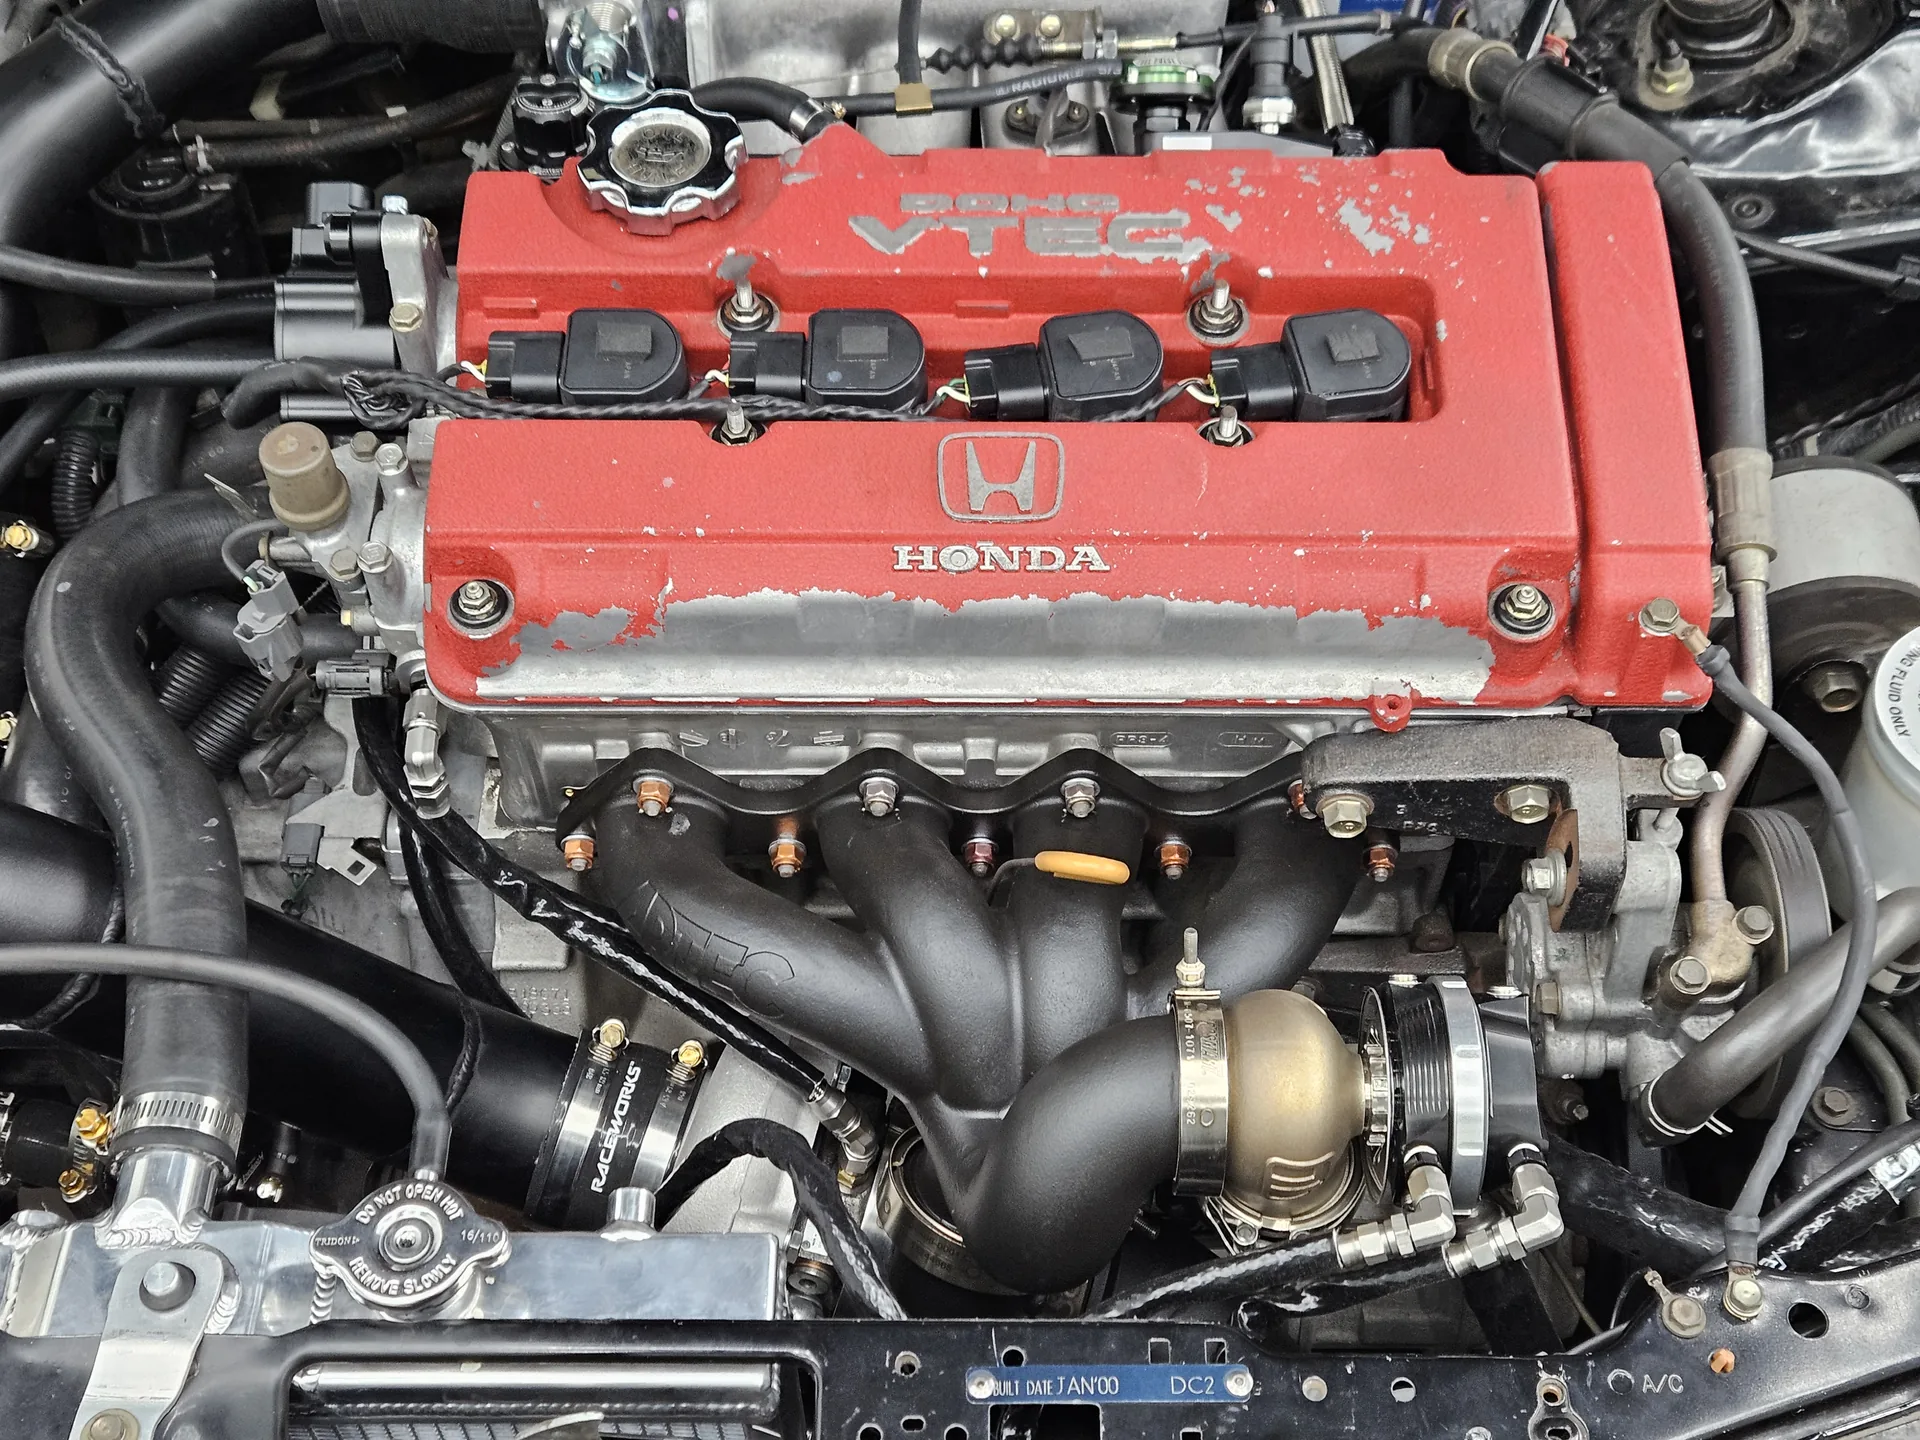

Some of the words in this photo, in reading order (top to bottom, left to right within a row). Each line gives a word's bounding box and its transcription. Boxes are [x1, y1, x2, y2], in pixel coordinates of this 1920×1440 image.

[900, 193, 1120, 212] DOHC
[848, 213, 1186, 256] VTEC
[893, 544, 1111, 573] HONDA
[1888, 667, 1908, 702] FLUID
[1889, 706, 1911, 737] ONLY
[590, 1064, 642, 1193] RACEWORKS
[355, 1203, 376, 1225] DO
[376, 1185, 402, 1209] NOT
[405, 1183, 444, 1204] OPEN
[439, 1195, 465, 1221] HOT
[315, 1237, 350, 1247] TRIDON
[461, 1229, 500, 1244] 16/110
[349, 1256, 400, 1296] REMOVE
[404, 1253, 458, 1295] SLOWLY
[992, 1379, 1020, 1397] BUILT
[1026, 1379, 1054, 1397] DATE
[1056, 1375, 1119, 1397] JAN'00
[1170, 1375, 1215, 1395] DC2
[1642, 1373, 1684, 1394] A/C
